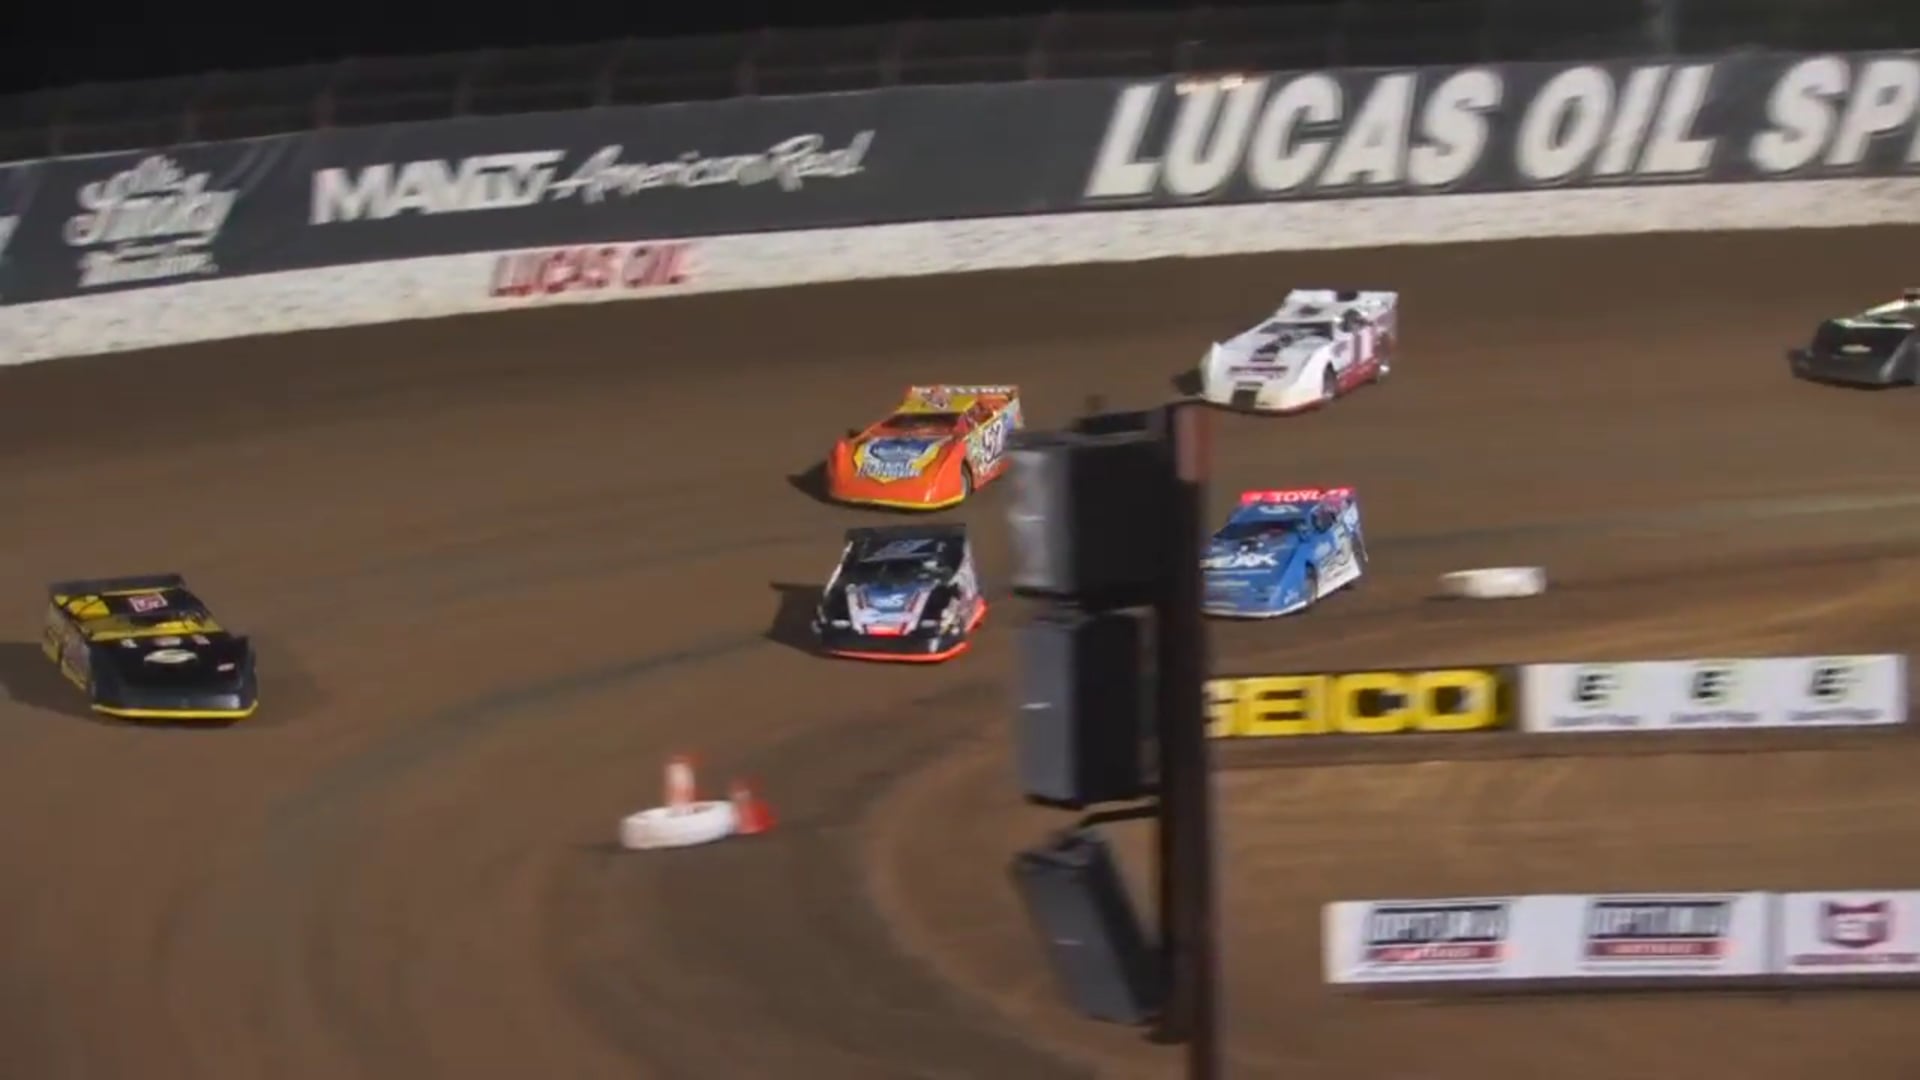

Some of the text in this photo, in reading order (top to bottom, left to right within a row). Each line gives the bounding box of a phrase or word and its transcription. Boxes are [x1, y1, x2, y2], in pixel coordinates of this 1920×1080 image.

[1083, 54, 1920, 199] LUCAS OIL SP
[308, 149, 567, 226] MAVTV
[489, 242, 692, 298] LUCAS OIL
